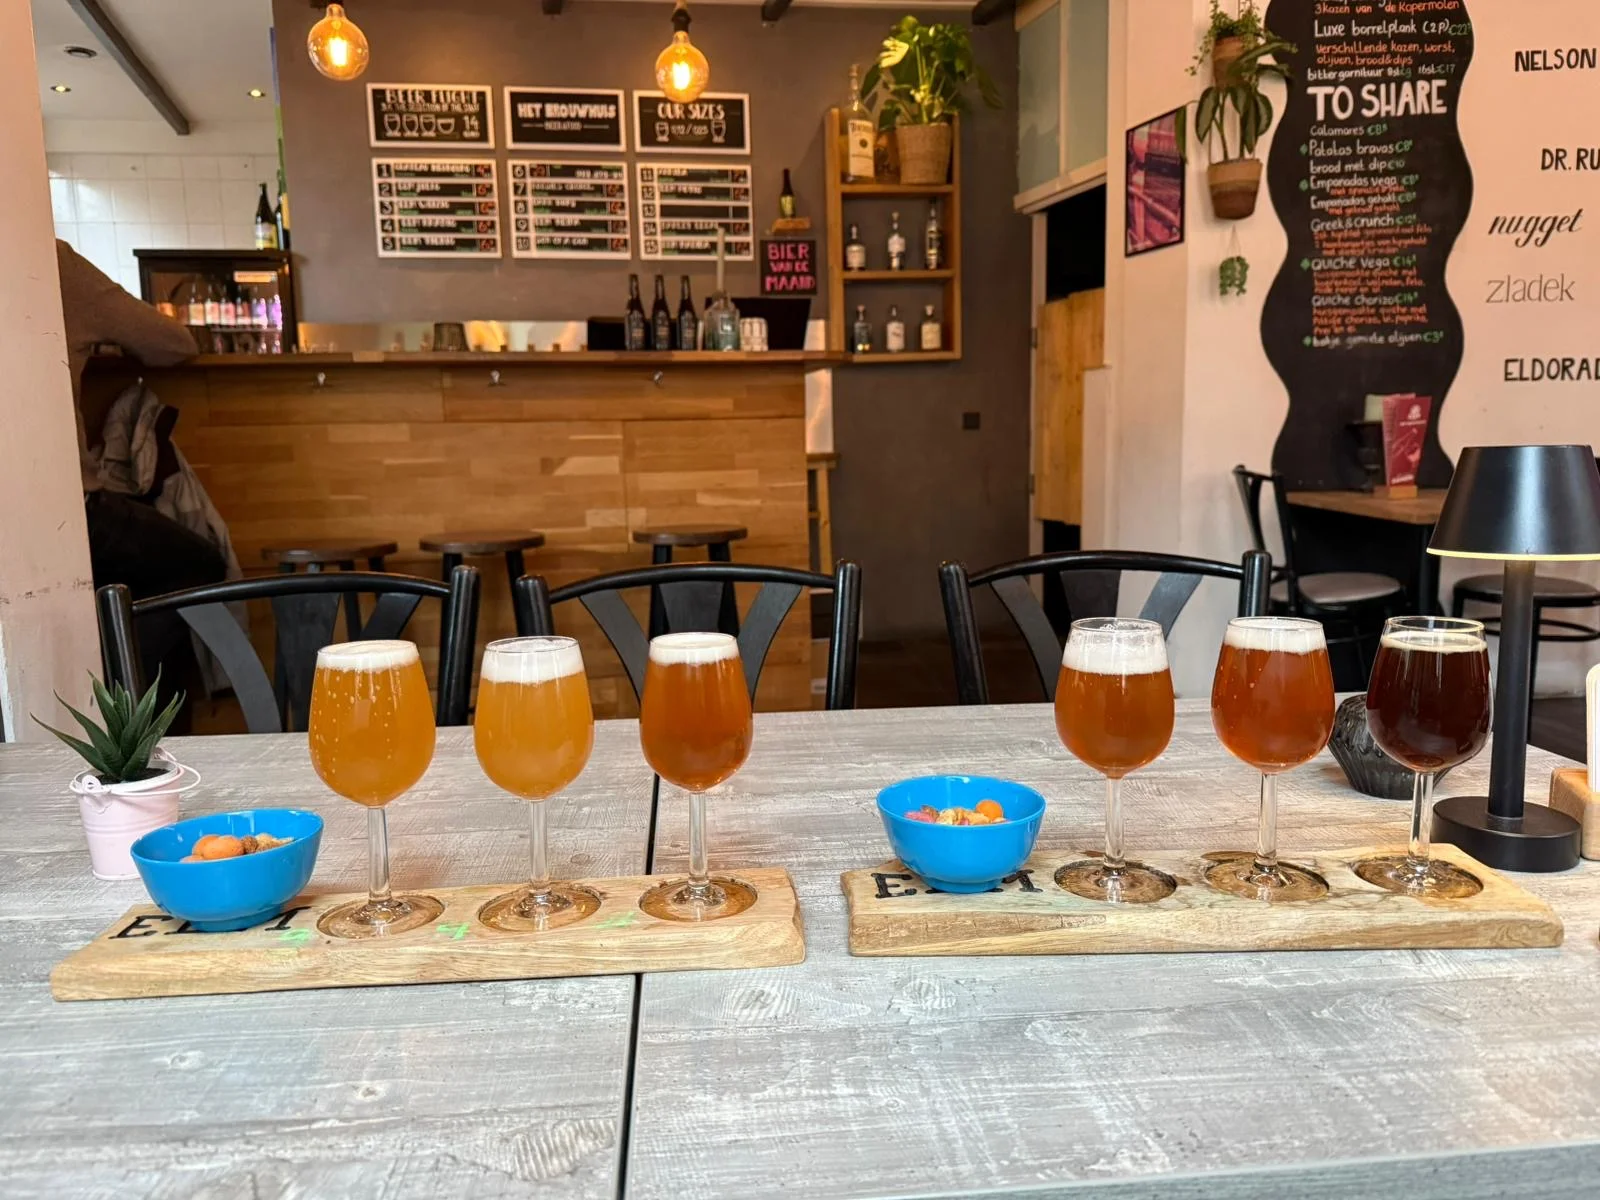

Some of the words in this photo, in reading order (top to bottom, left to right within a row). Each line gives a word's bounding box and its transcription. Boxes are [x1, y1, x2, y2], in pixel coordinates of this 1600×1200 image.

[1355, 4, 1373, 14] van
[1314, 19, 1346, 38] Luxe
[1352, 19, 1417, 38] borrelplank
[1515, 48, 1597, 72] NELSON
[1306, 85, 1354, 121] TO
[1361, 79, 1448, 118] SHARE
[517, 103, 543, 118] HET
[688, 103, 726, 120] SIZES
[463, 115, 479, 131] 14
[1310, 124, 1365, 136] Calamares
[1309, 139, 1352, 157] Patatas
[1356, 138, 1395, 154] bravas
[1310, 159, 1341, 174] brood
[1344, 160, 1365, 172] met
[1368, 156, 1387, 173] dip
[1541, 148, 1572, 171] DR.
[1310, 174, 1369, 193] Empanadas
[1488, 208, 1583, 248] nugget
[768, 243, 809, 260] BIER
[766, 275, 815, 291] MAAND
[1486, 273, 1575, 303] zladek
